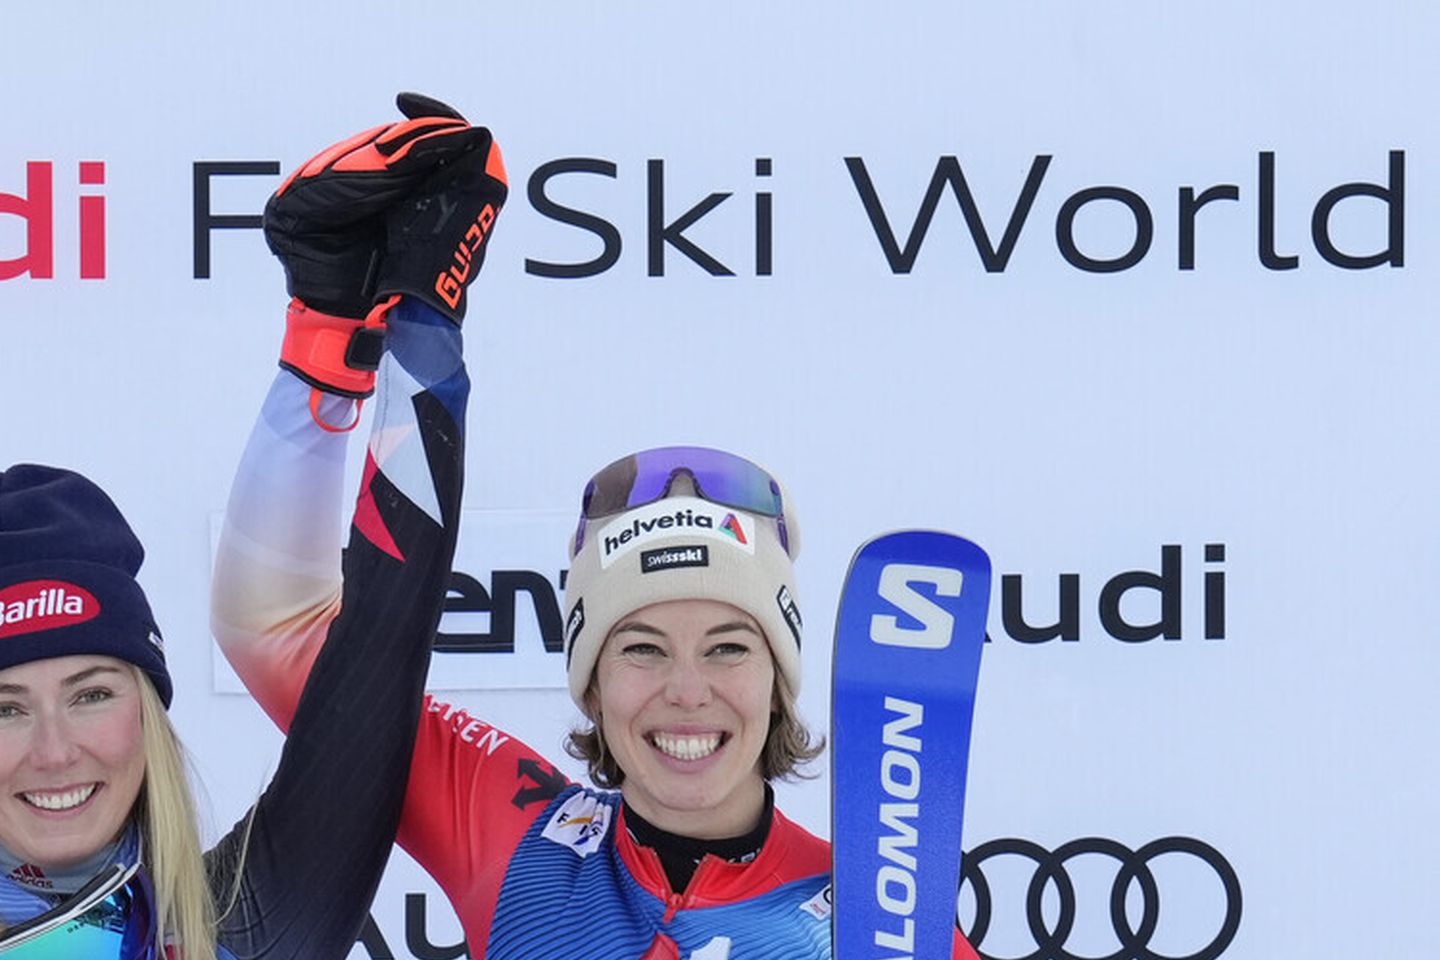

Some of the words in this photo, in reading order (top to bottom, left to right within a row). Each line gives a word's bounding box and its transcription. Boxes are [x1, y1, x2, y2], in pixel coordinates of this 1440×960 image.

[524, 157, 773, 278] Ski
[843, 150, 1406, 275] World
[605, 509, 713, 555] helvetia
[983, 543, 1225, 644] udi
